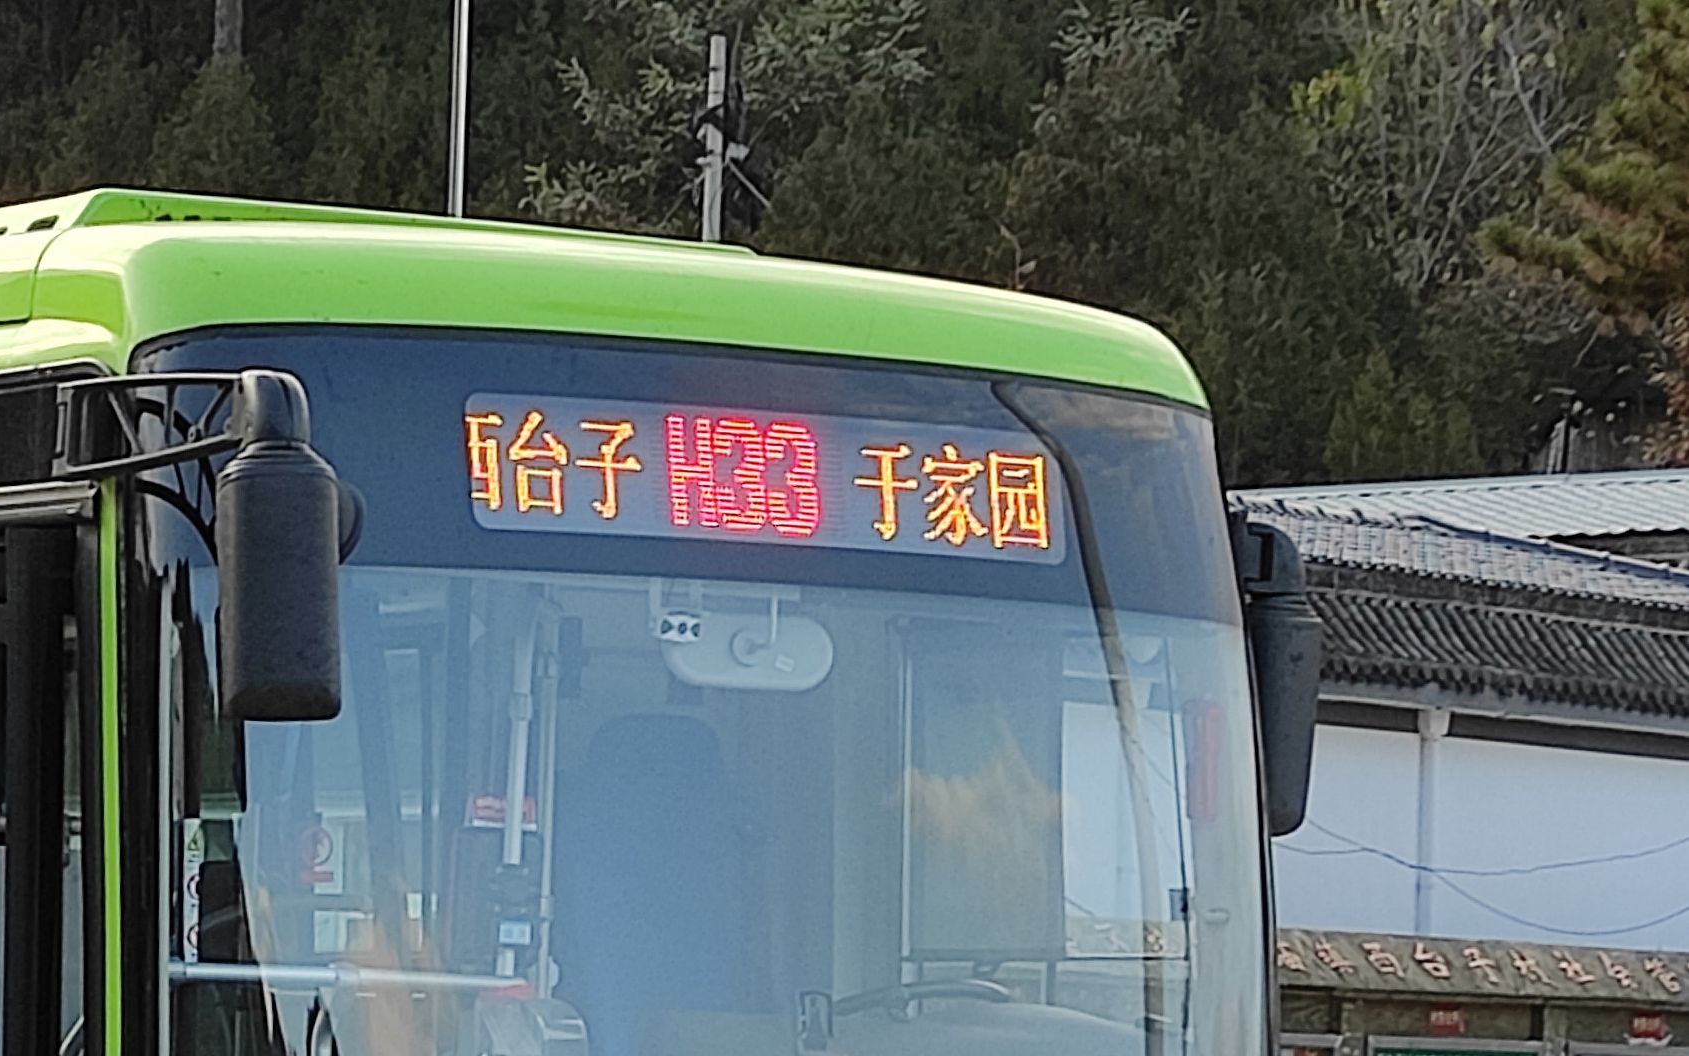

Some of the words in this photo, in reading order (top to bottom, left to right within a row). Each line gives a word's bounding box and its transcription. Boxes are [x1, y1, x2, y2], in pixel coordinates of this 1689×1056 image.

[664, 415, 818, 537] H33
[854, 443, 1050, 550] 于家园
